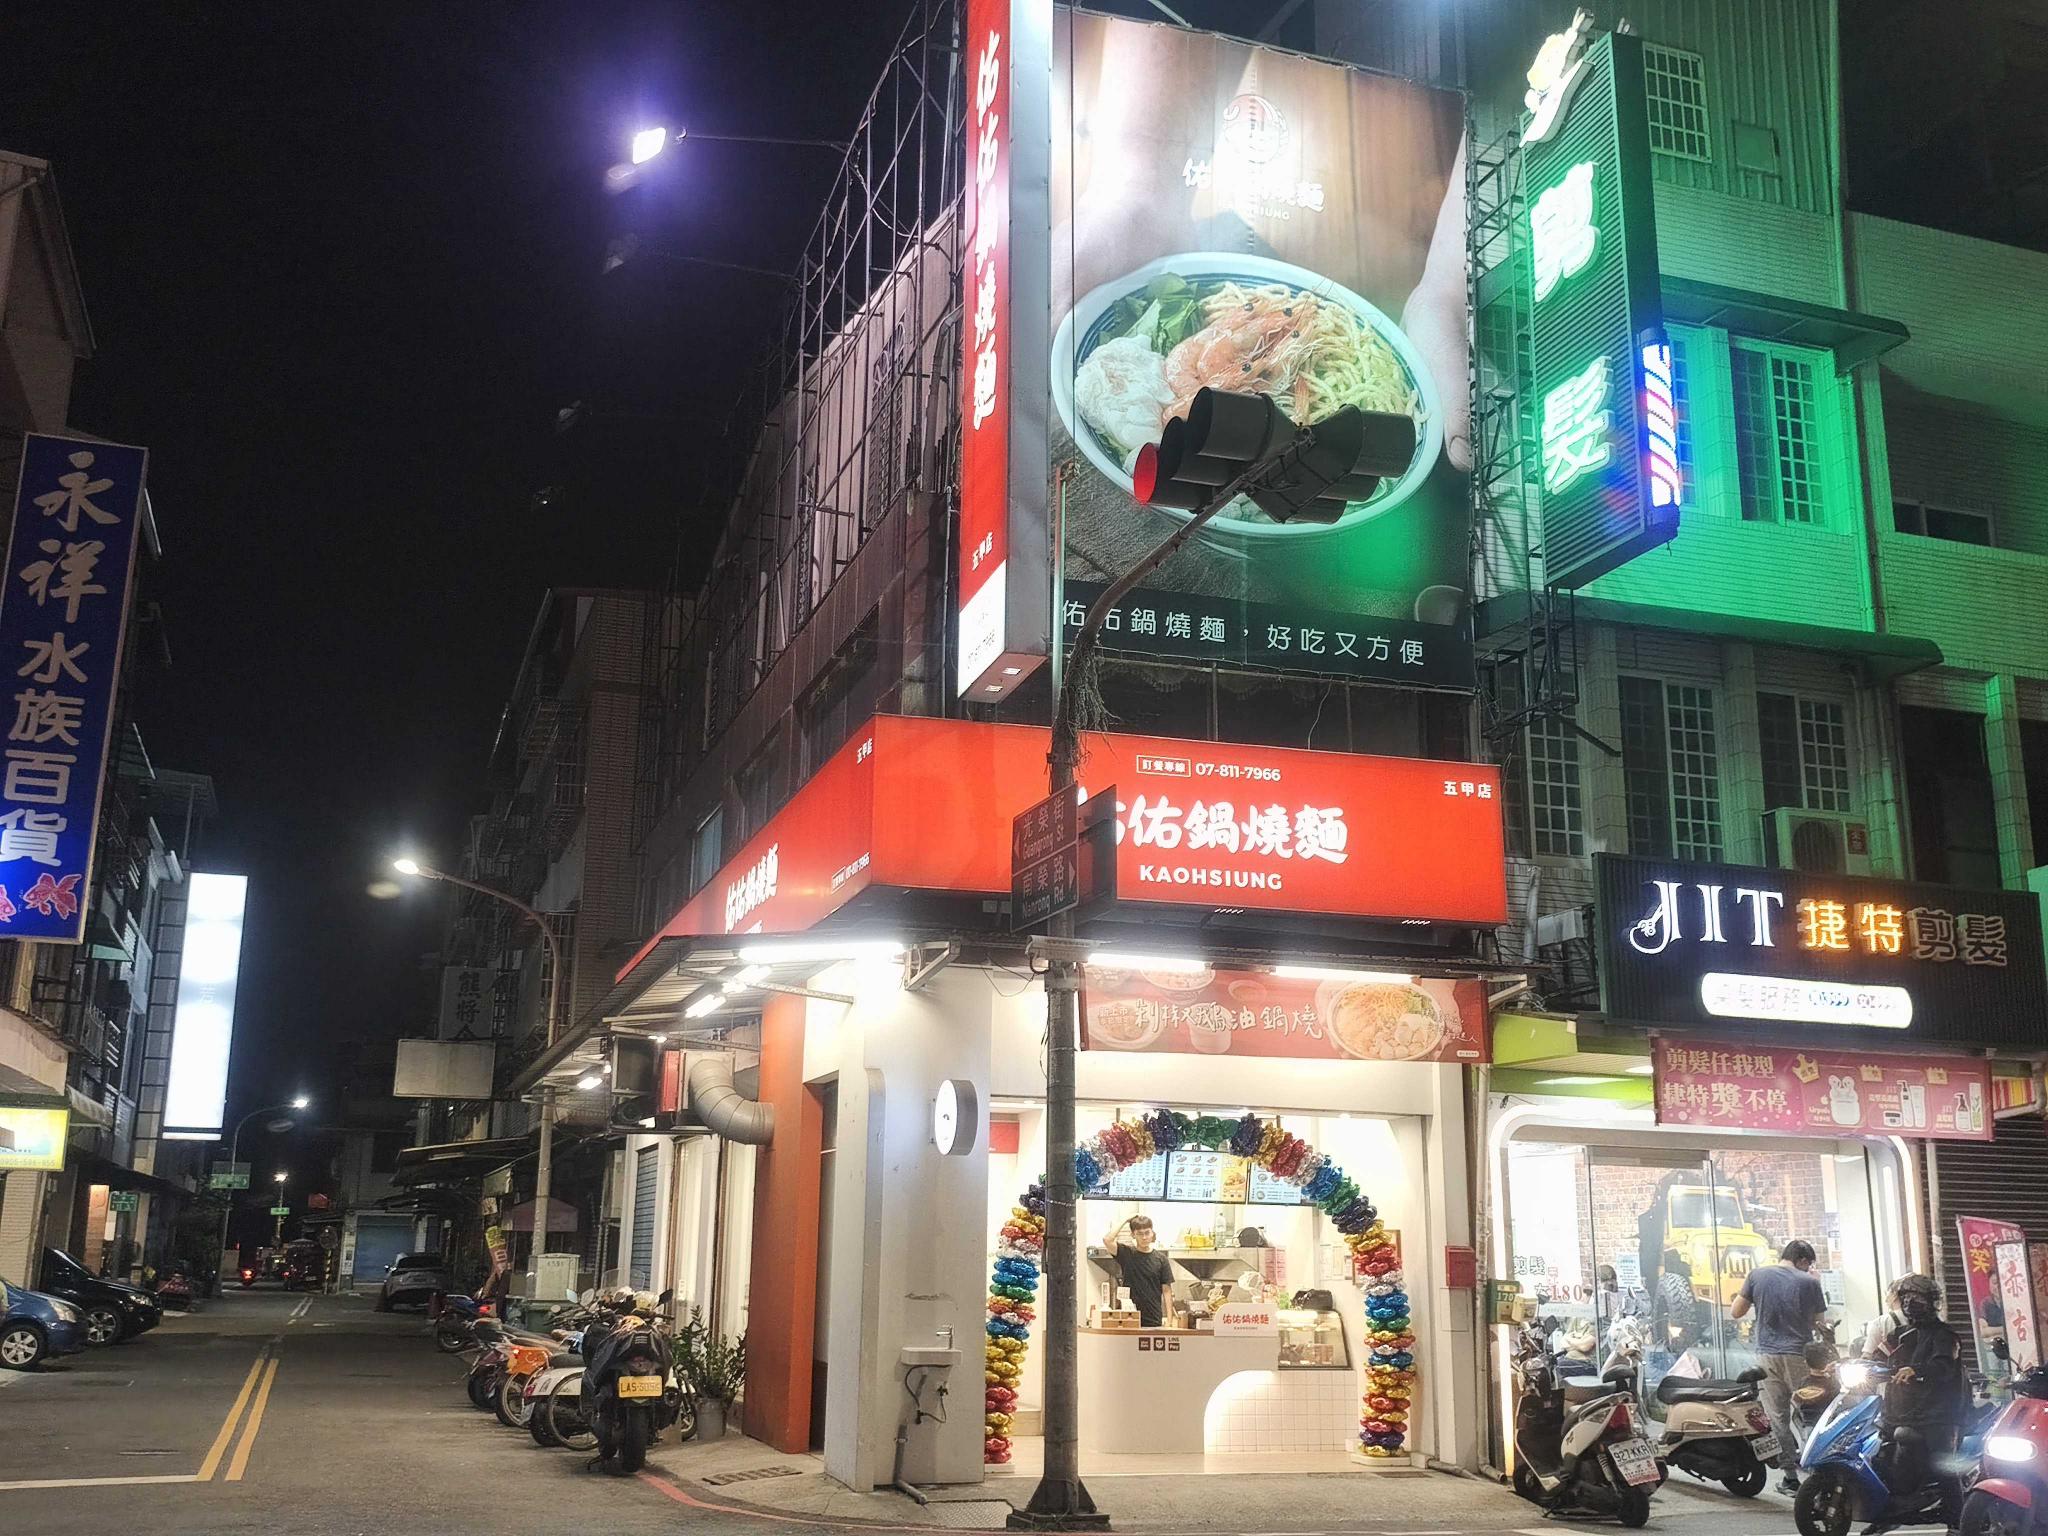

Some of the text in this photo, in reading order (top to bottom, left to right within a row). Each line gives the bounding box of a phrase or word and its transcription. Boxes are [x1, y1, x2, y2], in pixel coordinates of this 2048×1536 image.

[0, 451, 121, 867] 永祥水族百貨
[1195, 762, 1281, 782] 07-811-7966
[1443, 780, 1493, 799] 五甲店
[1023, 795, 1065, 840] 光榮街
[1056, 825, 1064, 842] St
[1079, 786, 1350, 864] 佑鍋燒麵
[1022, 855, 1065, 897] 南榮路
[1139, 865, 1283, 890] KAOHSIUNG
[1054, 884, 1065, 905] Rd
[1629, 880, 1784, 954] JIT
[1666, 1048, 1776, 1079] 剪髮任我型
[1663, 1082, 1788, 1117] 捷特獎不停
